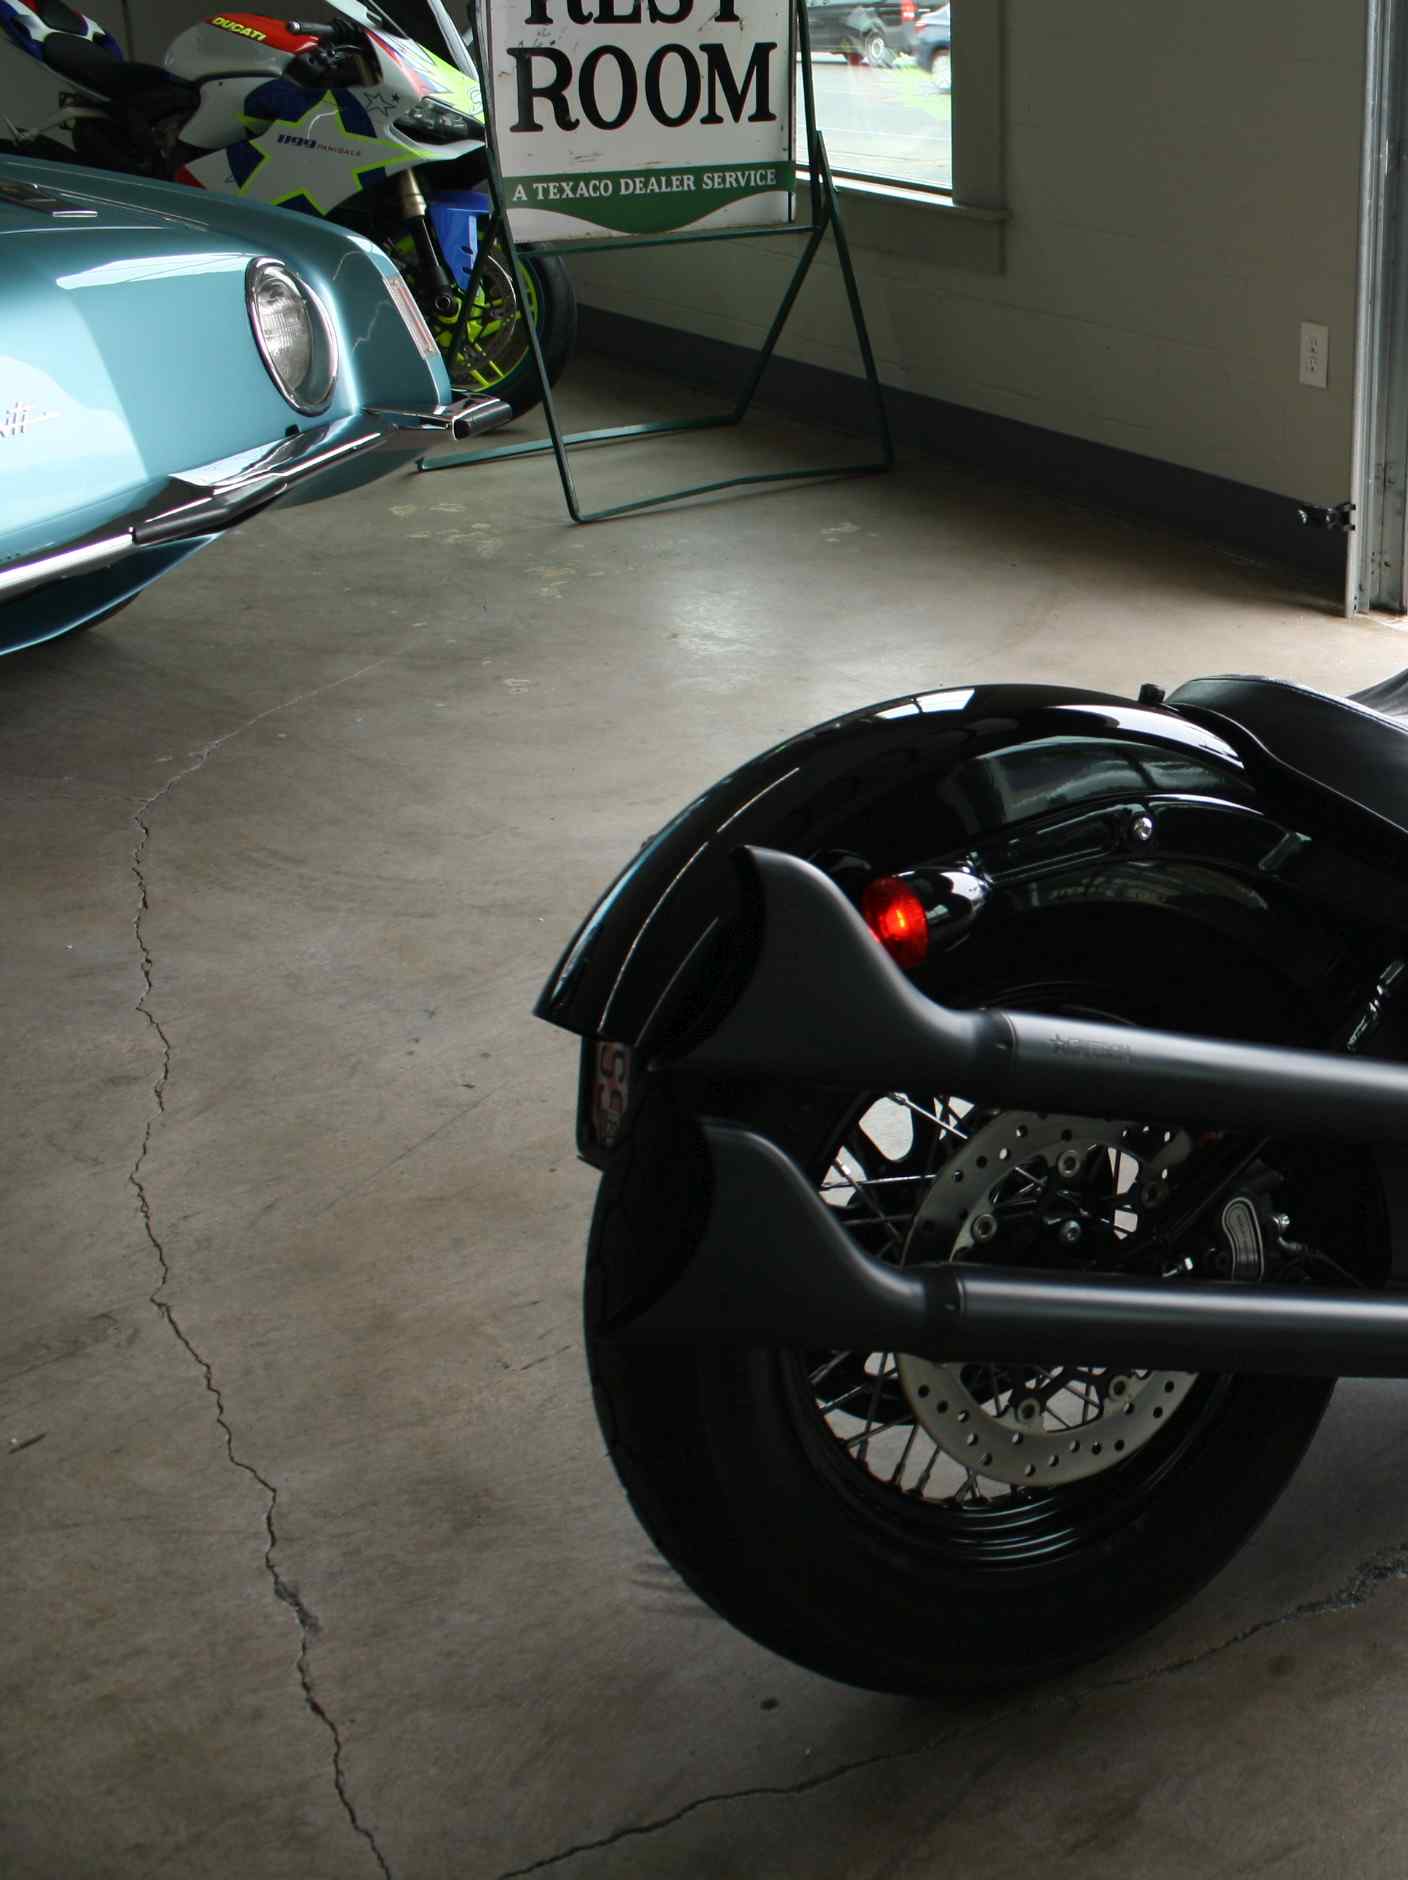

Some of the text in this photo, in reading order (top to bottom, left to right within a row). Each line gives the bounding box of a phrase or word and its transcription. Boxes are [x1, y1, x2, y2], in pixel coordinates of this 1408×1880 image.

[212, 16, 267, 41] DUCATI
[506, 41, 778, 132] ROOM
[512, 168, 777, 201] A TEXACO DEALER SERVICE
